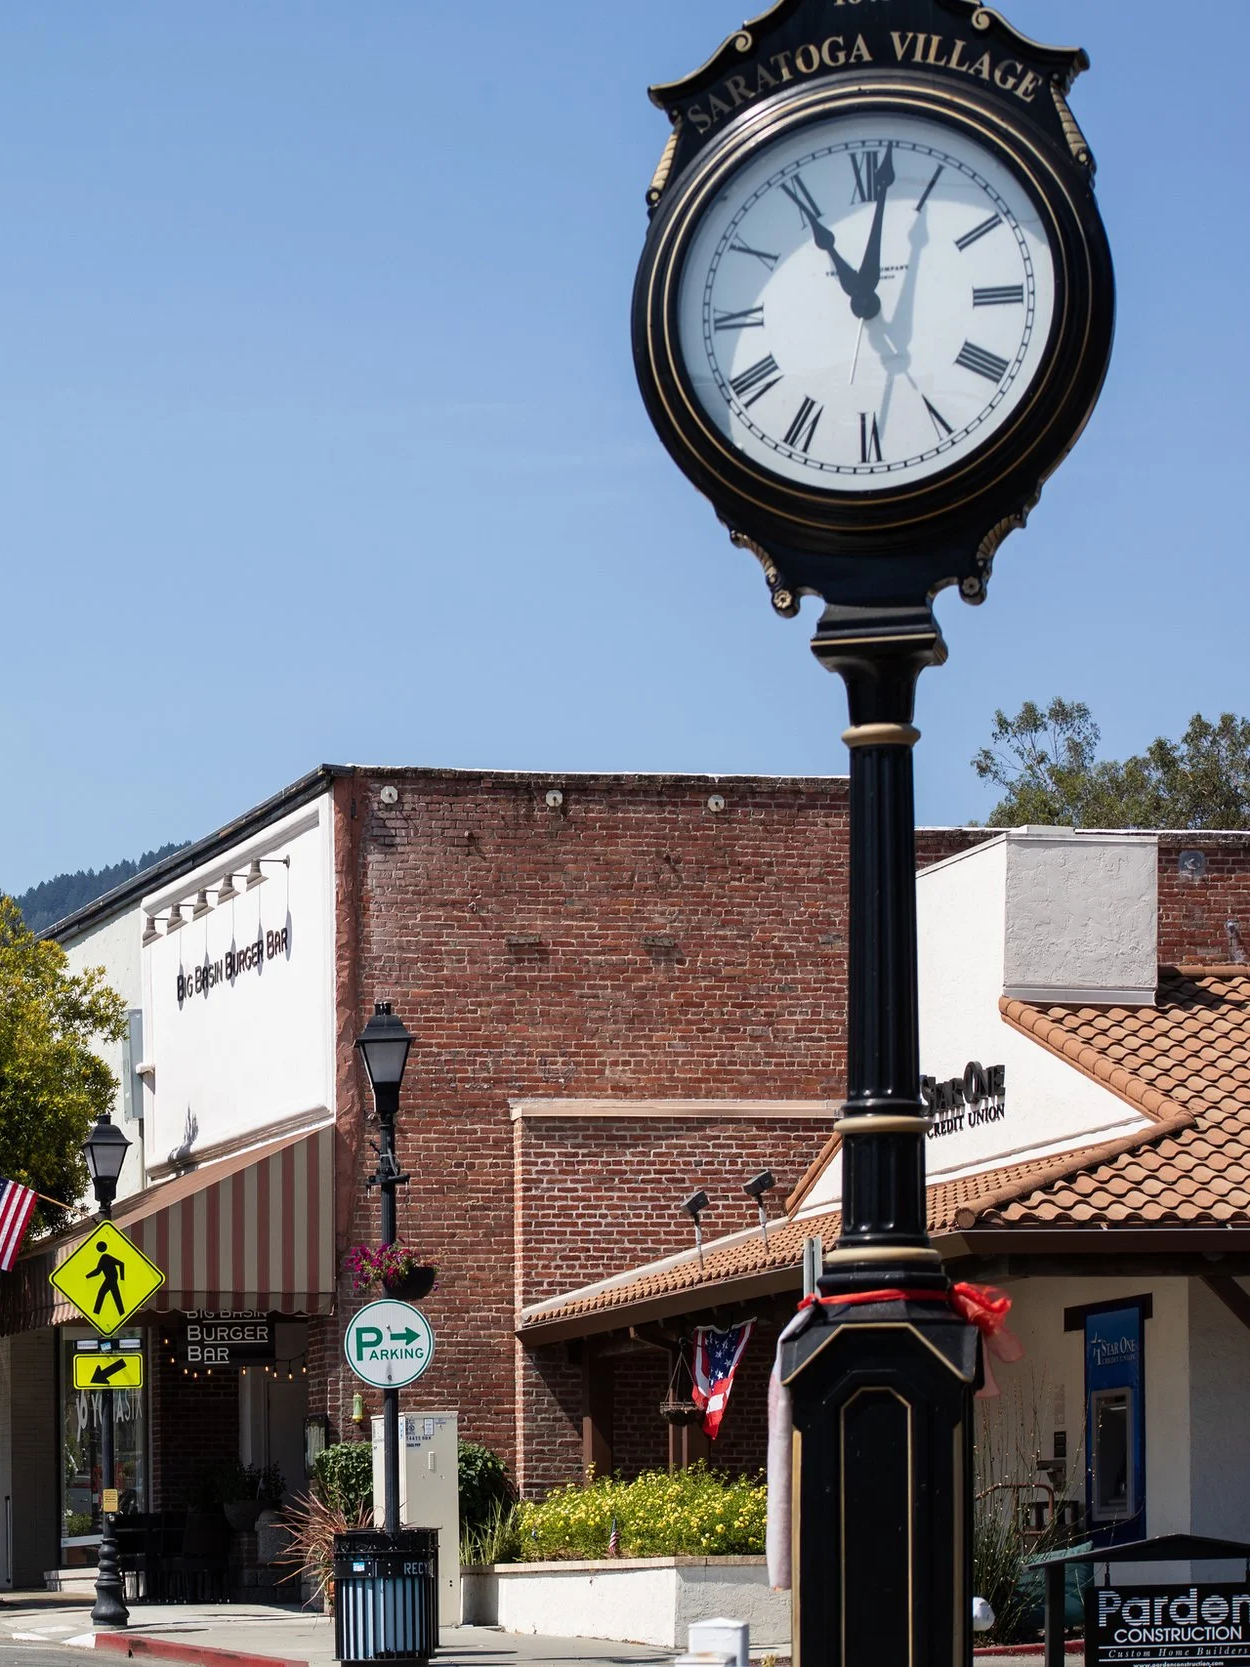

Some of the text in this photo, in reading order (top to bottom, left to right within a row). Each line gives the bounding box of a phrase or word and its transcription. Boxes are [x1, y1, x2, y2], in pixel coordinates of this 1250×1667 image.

[688, 31, 1043, 134] SARATOGA VILLAGE
[915, 164, 945, 212] I
[954, 212, 1003, 252] II
[728, 233, 780, 271] X
[972, 283, 1024, 309] III
[714, 302, 764, 333] IX
[727, 352, 784, 409] VIII
[783, 395, 824, 454] VII
[922, 392, 957, 440] V
[857, 411, 886, 463] VI
[177, 927, 288, 1001] BIG BASIN BURGER BAR
[926, 1104, 1005, 1140] CREDIT UNION
[187, 1325, 268, 1341] BURGER
[356, 1327, 424, 1361] PARKING
[1101, 1340, 1119, 1356] STAR
[1120, 1336, 1135, 1353] ONE
[188, 1345, 229, 1361] BAR
[91, 1388, 142, 1428] YASIX
[1108, 1645, 1248, 1658] Custom Home Builders
[1114, 1626, 1242, 1643] CONSTRUCTION
